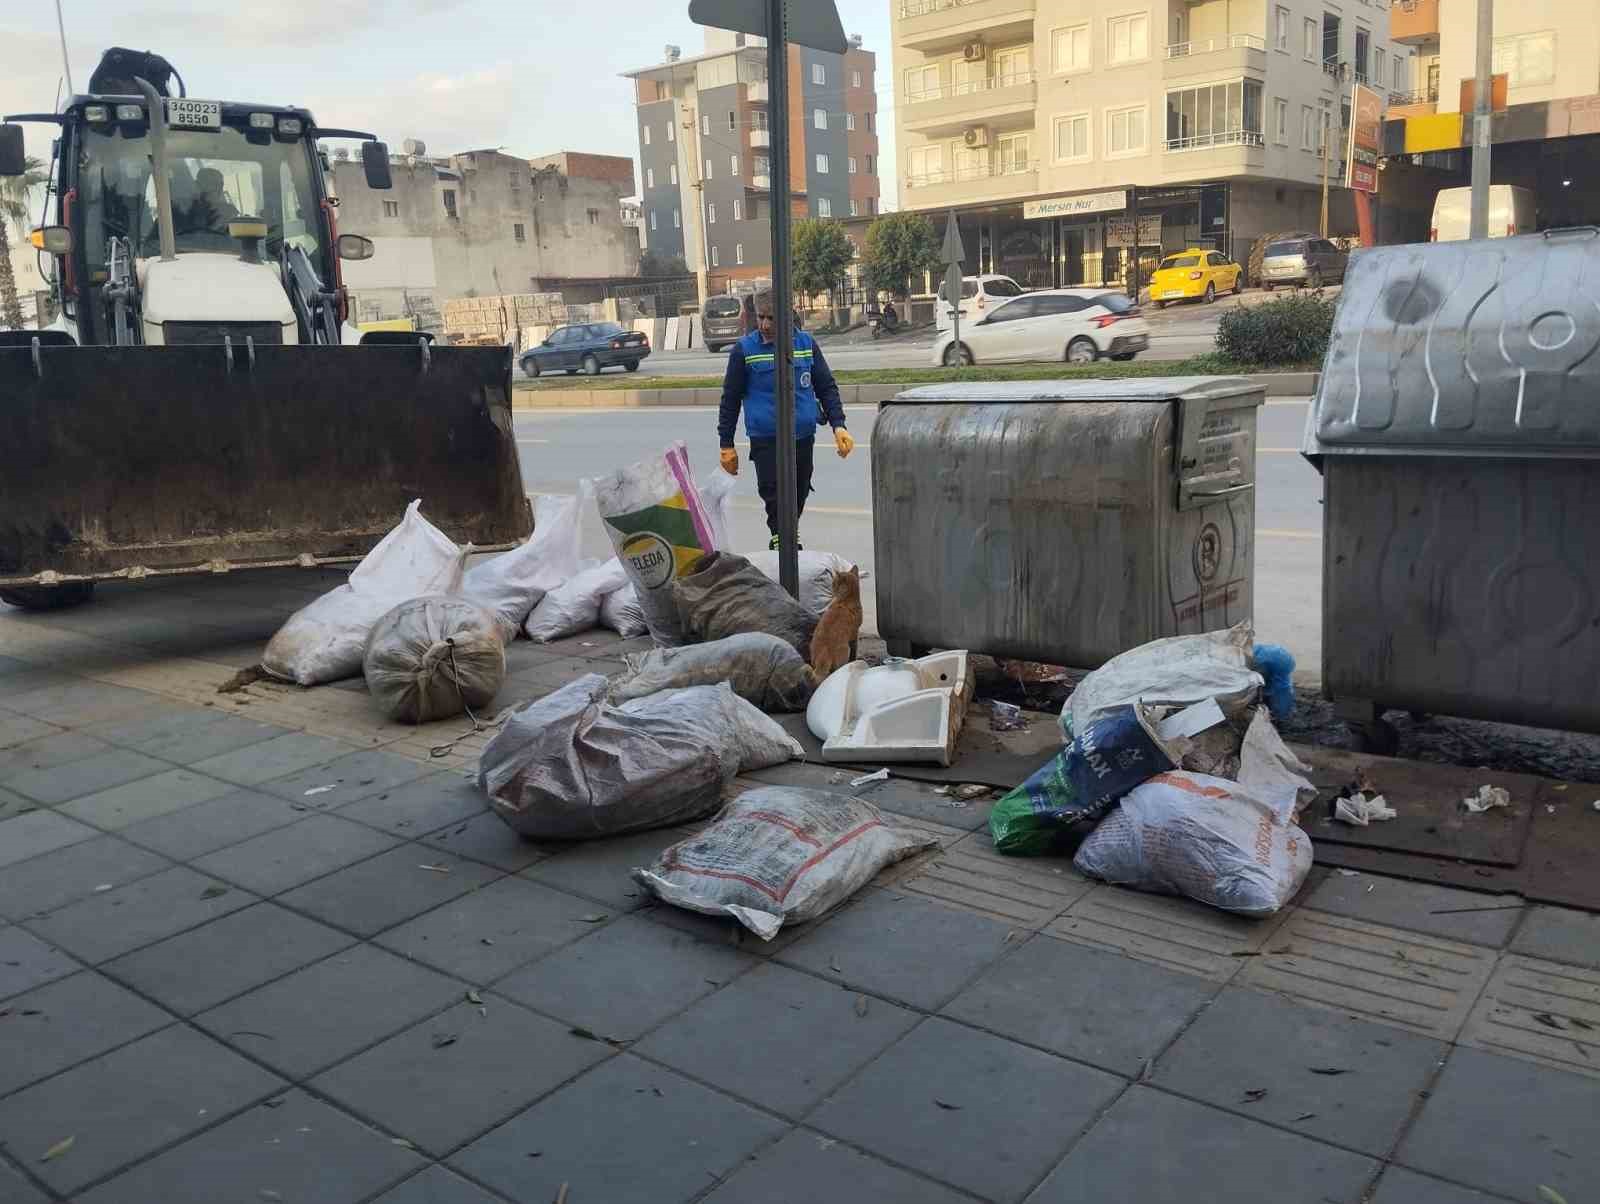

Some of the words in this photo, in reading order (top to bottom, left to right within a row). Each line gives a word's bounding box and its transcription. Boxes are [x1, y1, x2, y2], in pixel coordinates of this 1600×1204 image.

[171, 102, 217, 114] 340023
[178, 113, 209, 125] 8550
[1038, 201, 1073, 214] Mersin
